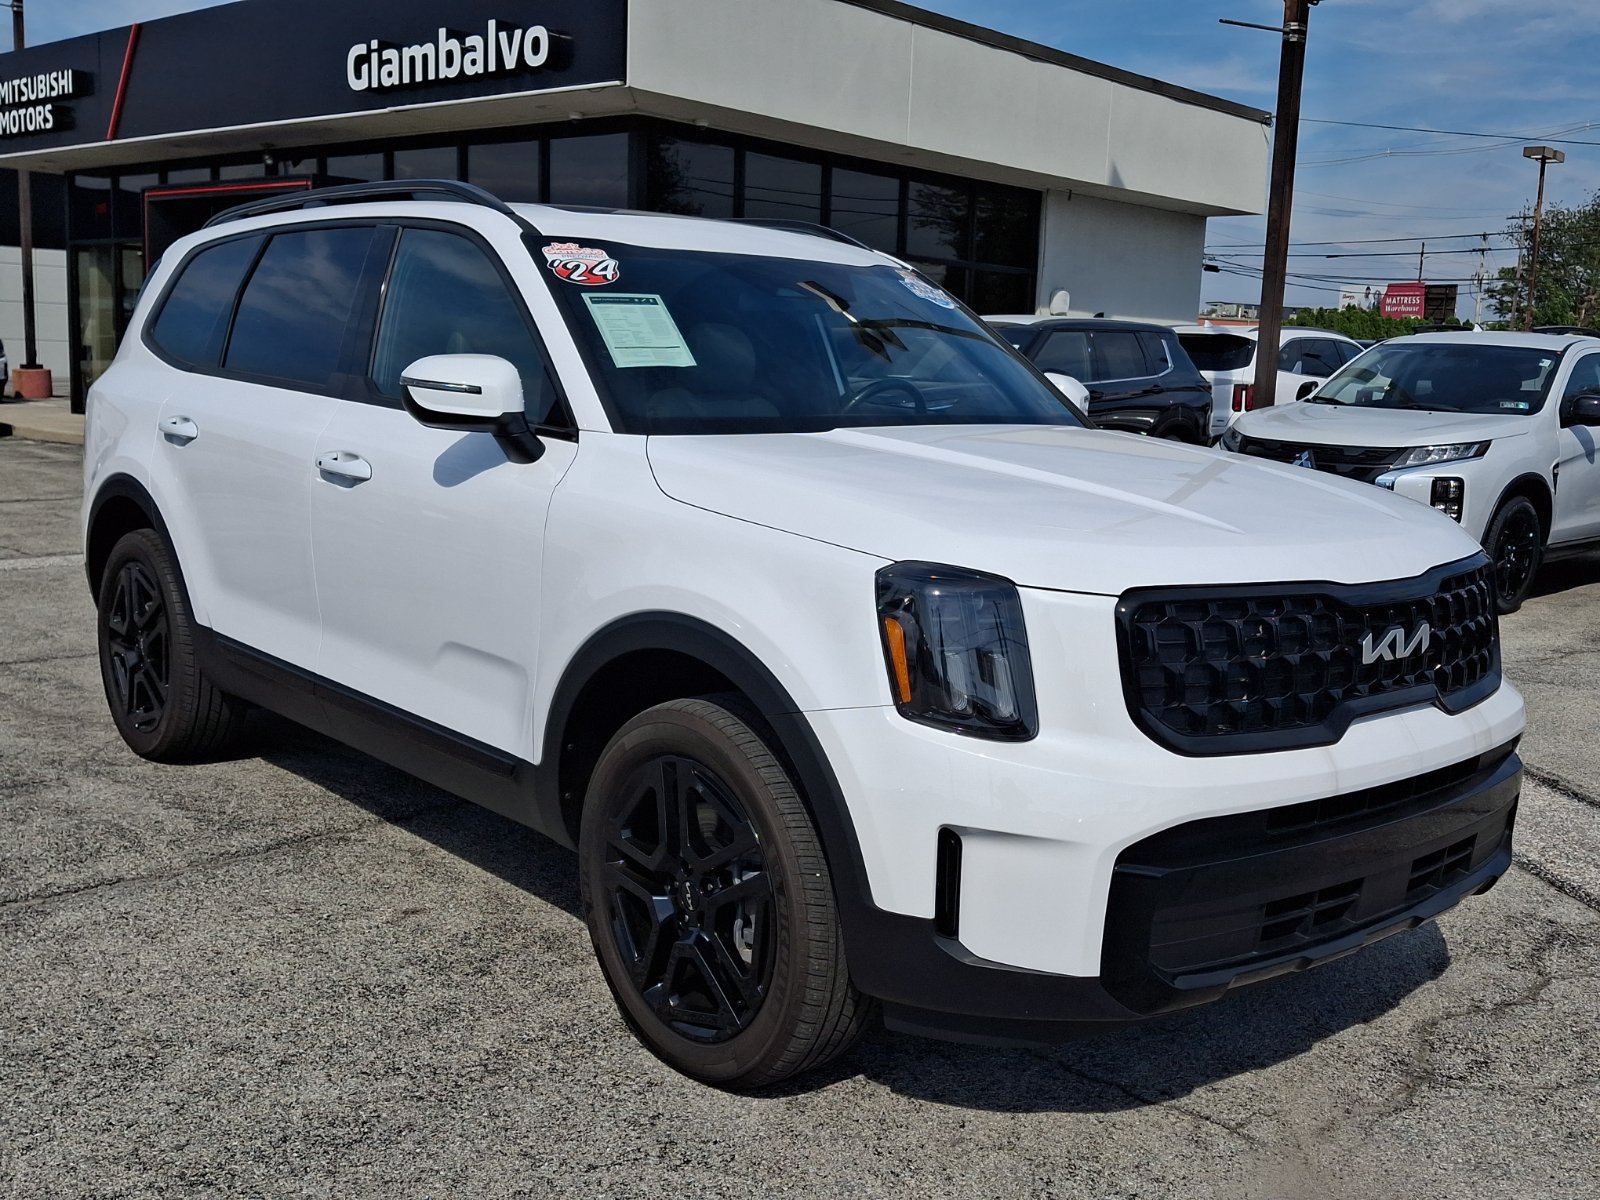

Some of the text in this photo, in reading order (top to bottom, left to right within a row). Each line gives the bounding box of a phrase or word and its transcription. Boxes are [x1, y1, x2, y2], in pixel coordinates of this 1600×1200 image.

[347, 19, 549, 91] Giambalvo
[0, 69, 73, 104] MITSUBISHI
[0, 104, 53, 135] MOTORS
[1385, 296, 1420, 304] MATTRESS
[1385, 304, 1420, 312] Warehouse
[1362, 623, 1430, 665] KIA
